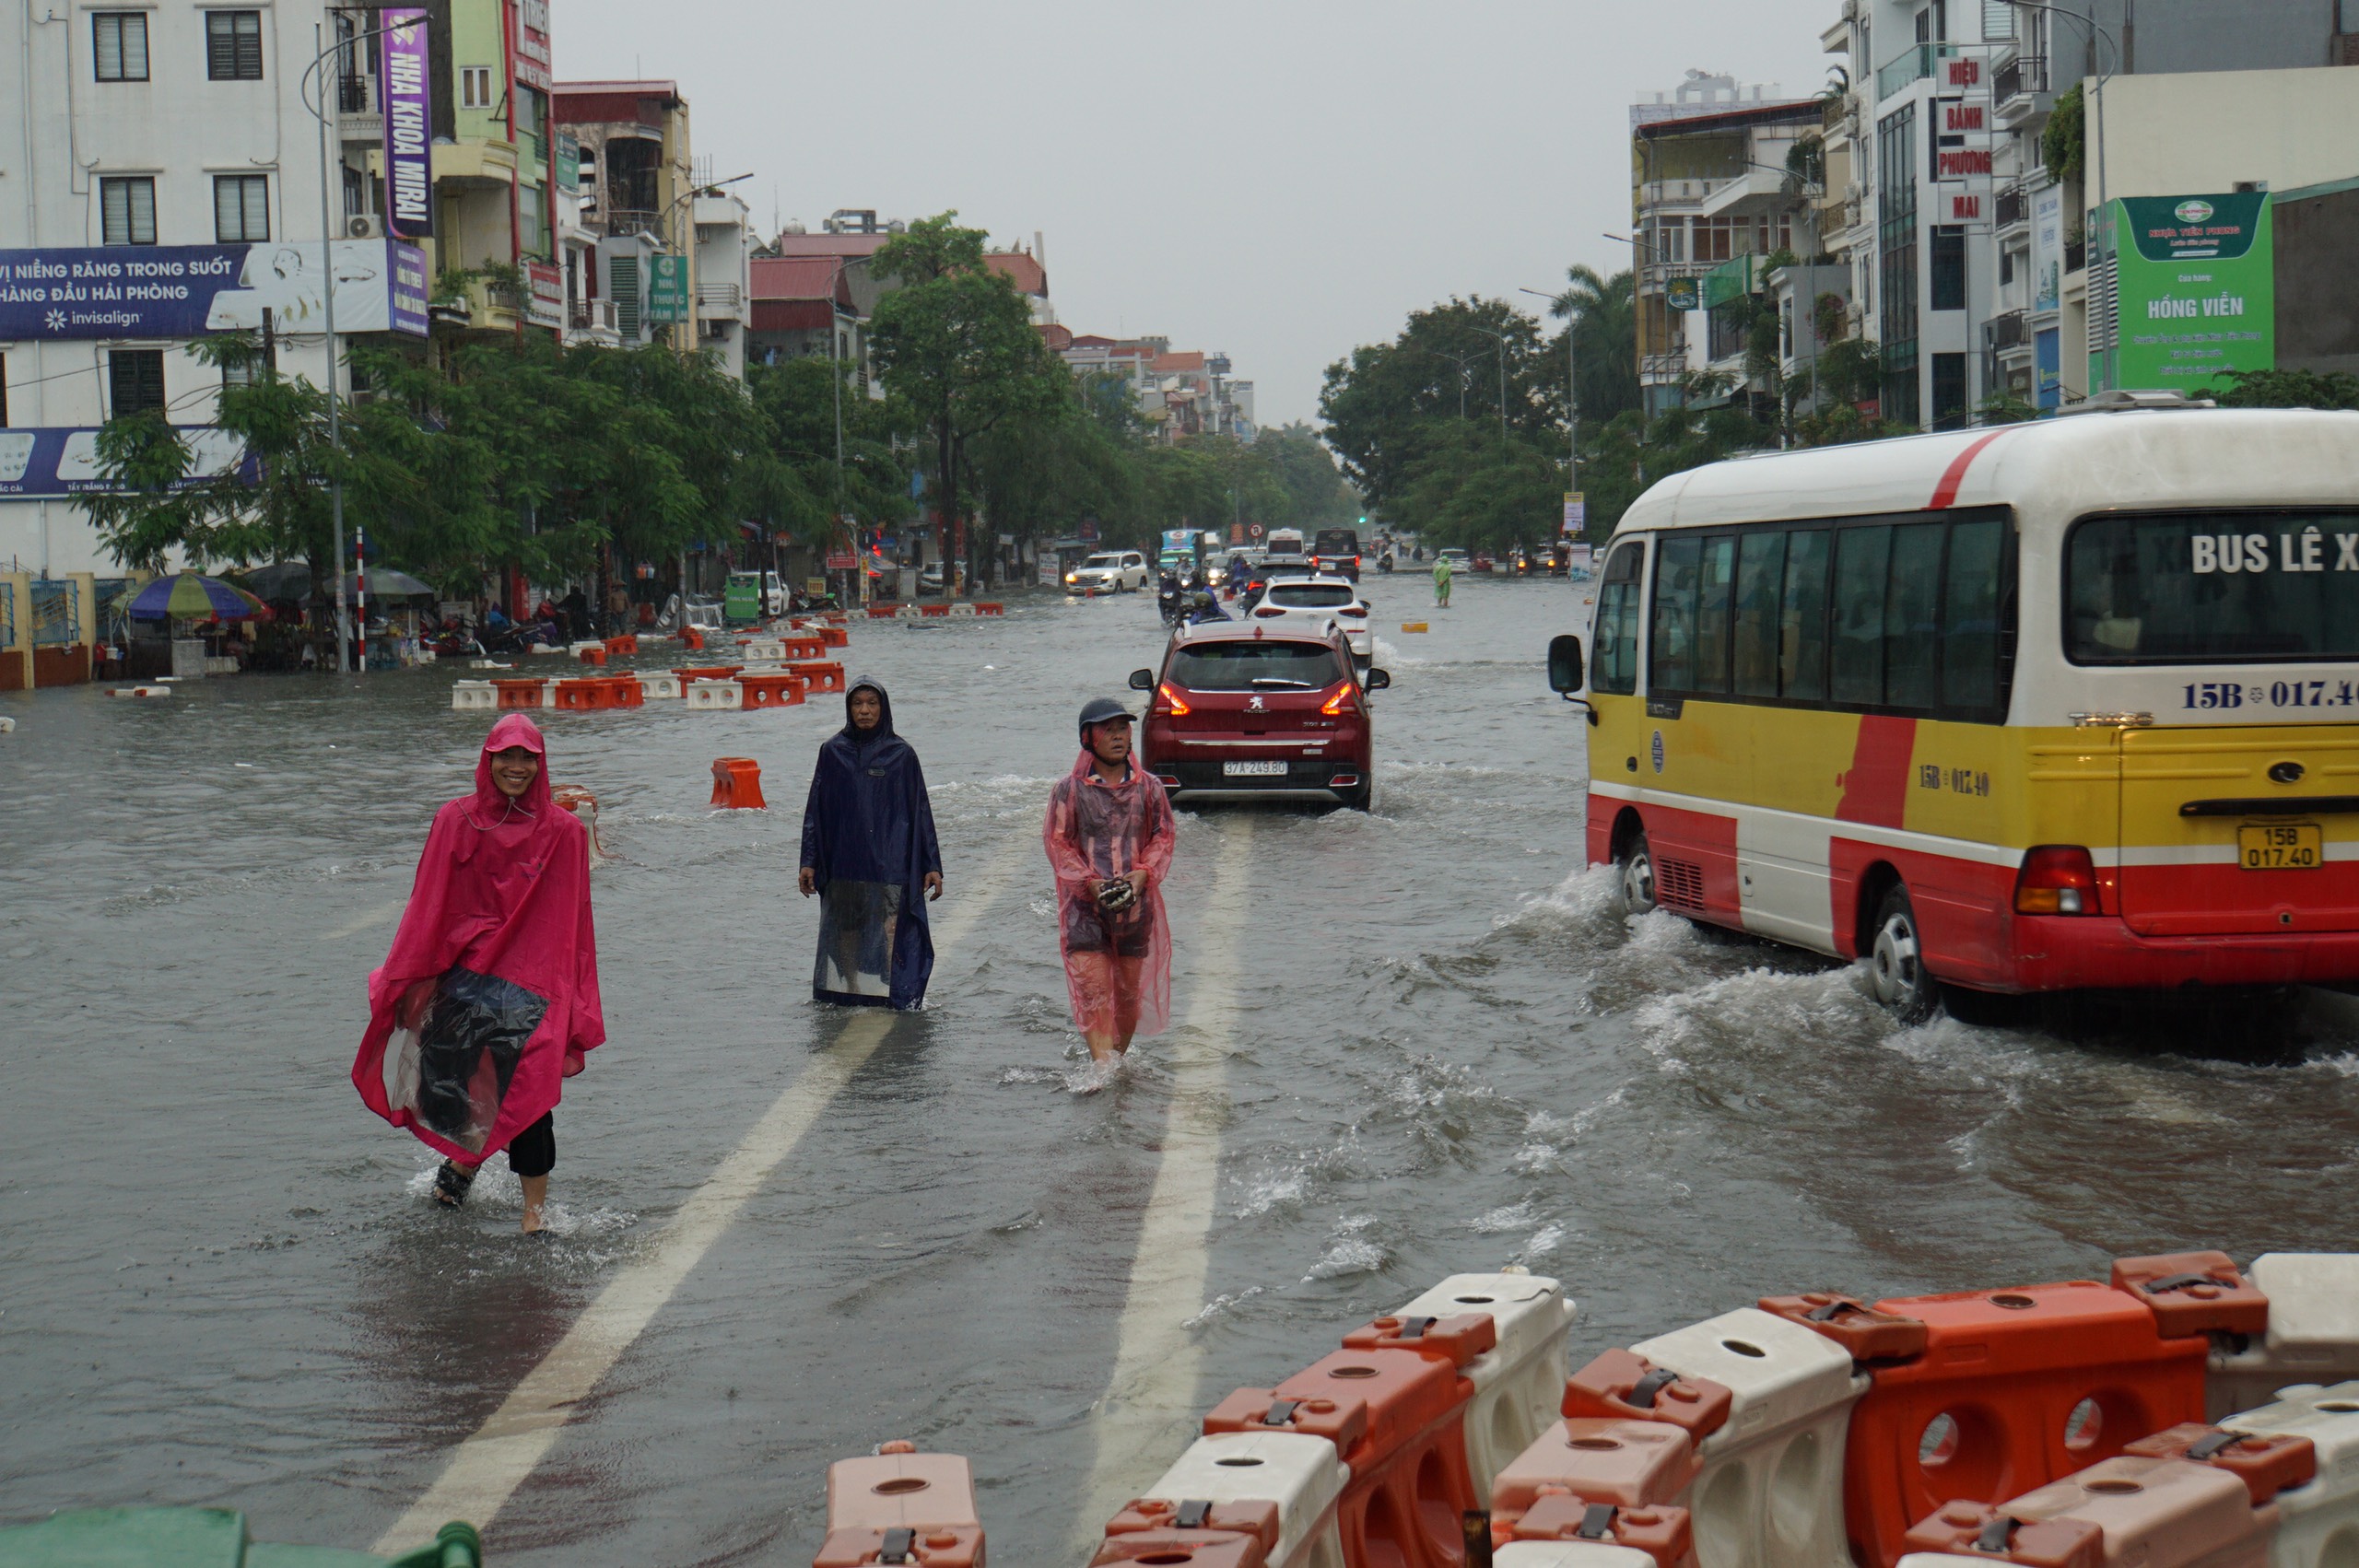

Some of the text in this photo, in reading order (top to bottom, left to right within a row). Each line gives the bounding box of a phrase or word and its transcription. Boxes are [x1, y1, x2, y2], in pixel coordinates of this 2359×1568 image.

[390, 52, 422, 95] NHA
[1949, 57, 1978, 88] HIỆU
[392, 100, 425, 155] KHOA
[1947, 103, 1983, 131] BÁNH
[1939, 150, 1991, 175] PHƯƠNG
[394, 160, 427, 222] MIRAI
[1953, 195, 1978, 219] MAI
[2206, 226, 2240, 236] PHONG
[16, 258, 67, 279] NIỀNG
[73, 261, 121, 278] RĂNG
[125, 262, 184, 277] TRONG
[189, 255, 232, 275] SUỐT
[51, 281, 87, 302] ĐẦU
[92, 282, 122, 301] HẢI
[126, 282, 189, 300] PHÒNG
[2148, 291, 2243, 319] HỒNG VIỄN
[72, 310, 140, 327] invisalign
[2191, 533, 2270, 573] BUS
[2280, 526, 2324, 572] LÊ
[2182, 680, 2359, 708] 15B 017.4
[2265, 828, 2297, 846] 15B
[2248, 848, 2313, 866] 017.40
